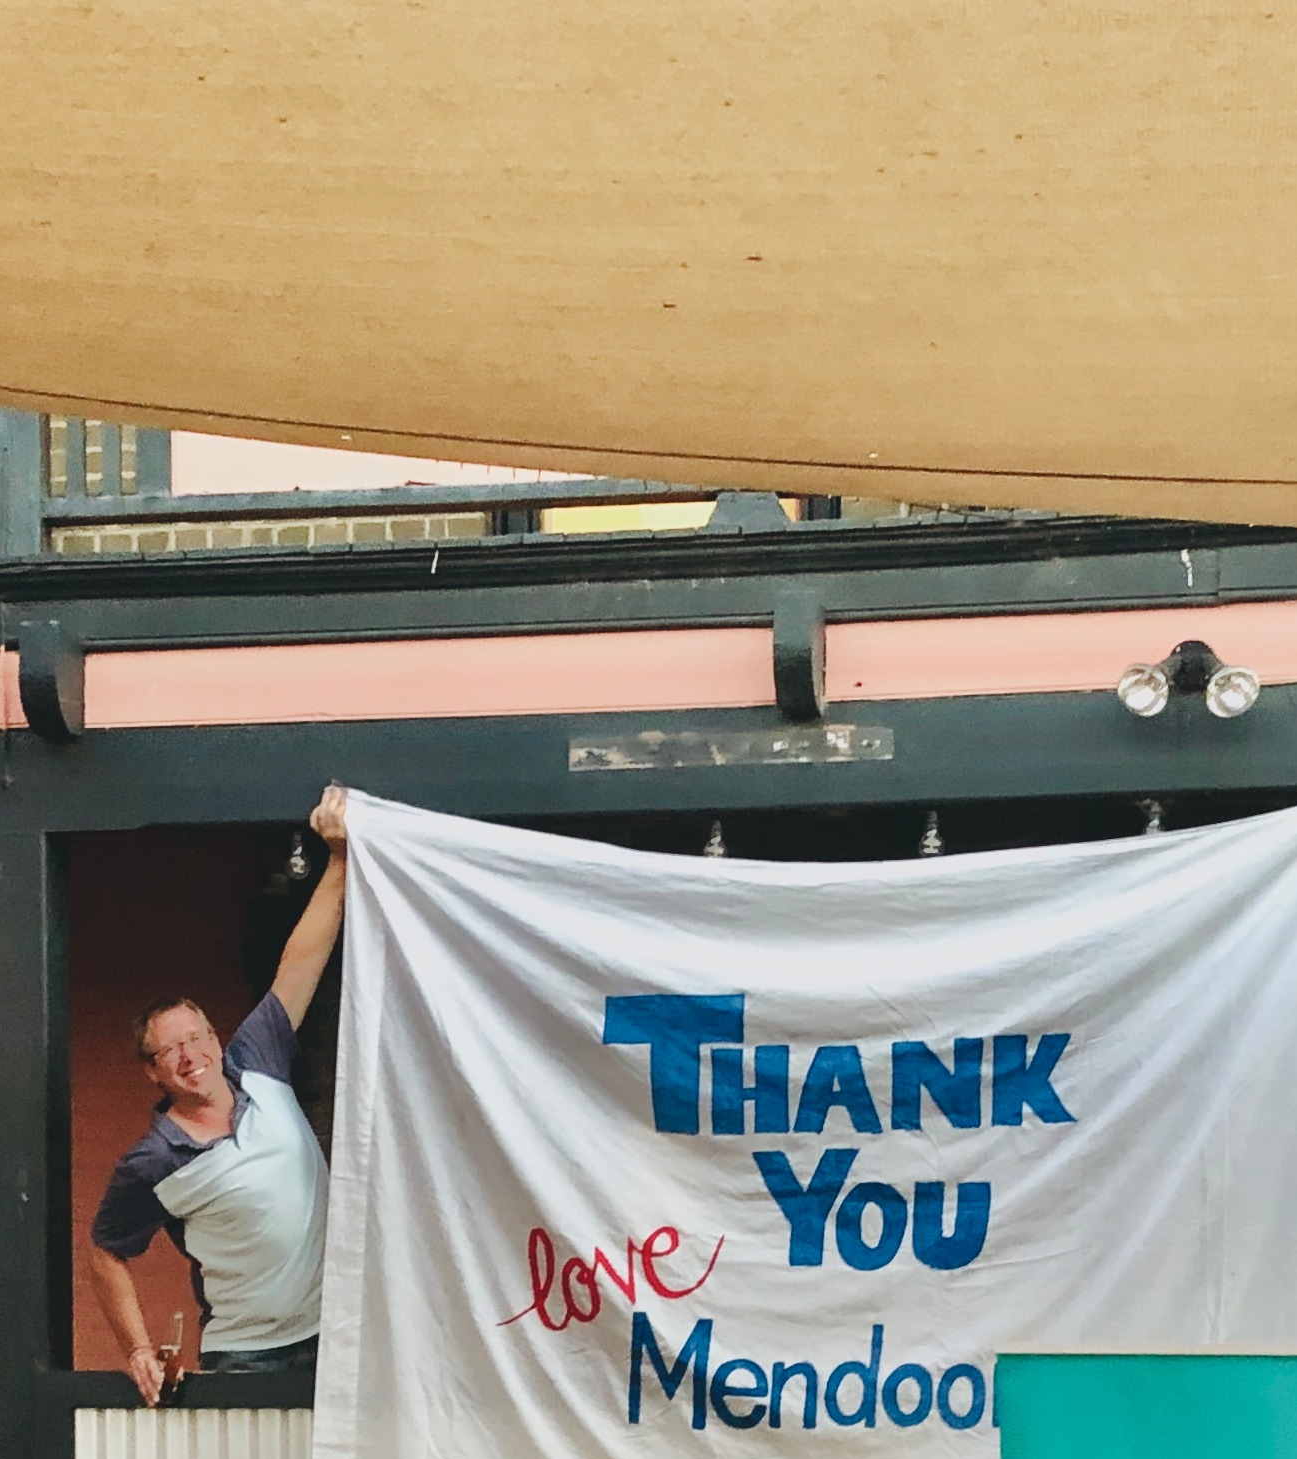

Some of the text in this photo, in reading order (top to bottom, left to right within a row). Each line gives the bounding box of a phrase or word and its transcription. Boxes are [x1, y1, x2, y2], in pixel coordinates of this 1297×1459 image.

[603, 993, 1078, 1136] THANK
[752, 1147, 992, 1271] YOU
[497, 1226, 726, 1331] love
[629, 1311, 1001, 1431] Mendoo
